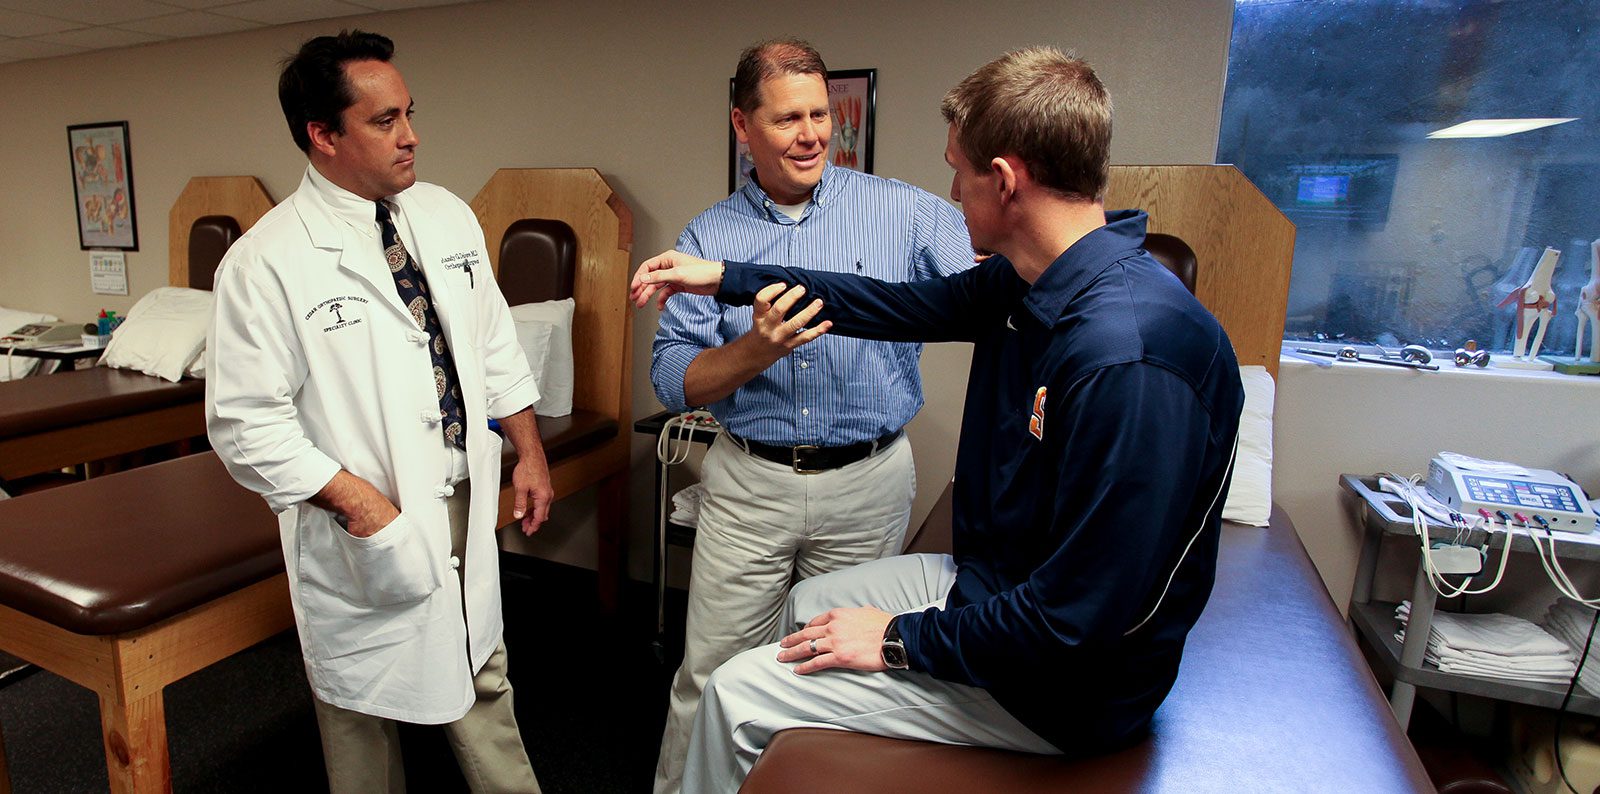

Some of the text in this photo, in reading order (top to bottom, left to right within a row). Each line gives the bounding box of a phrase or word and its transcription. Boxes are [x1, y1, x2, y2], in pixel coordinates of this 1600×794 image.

[305, 296, 369, 321] CEDAR ORTHOPAEDIC SURGERY
[323, 318, 362, 333] SPECIALTY CLINIC
